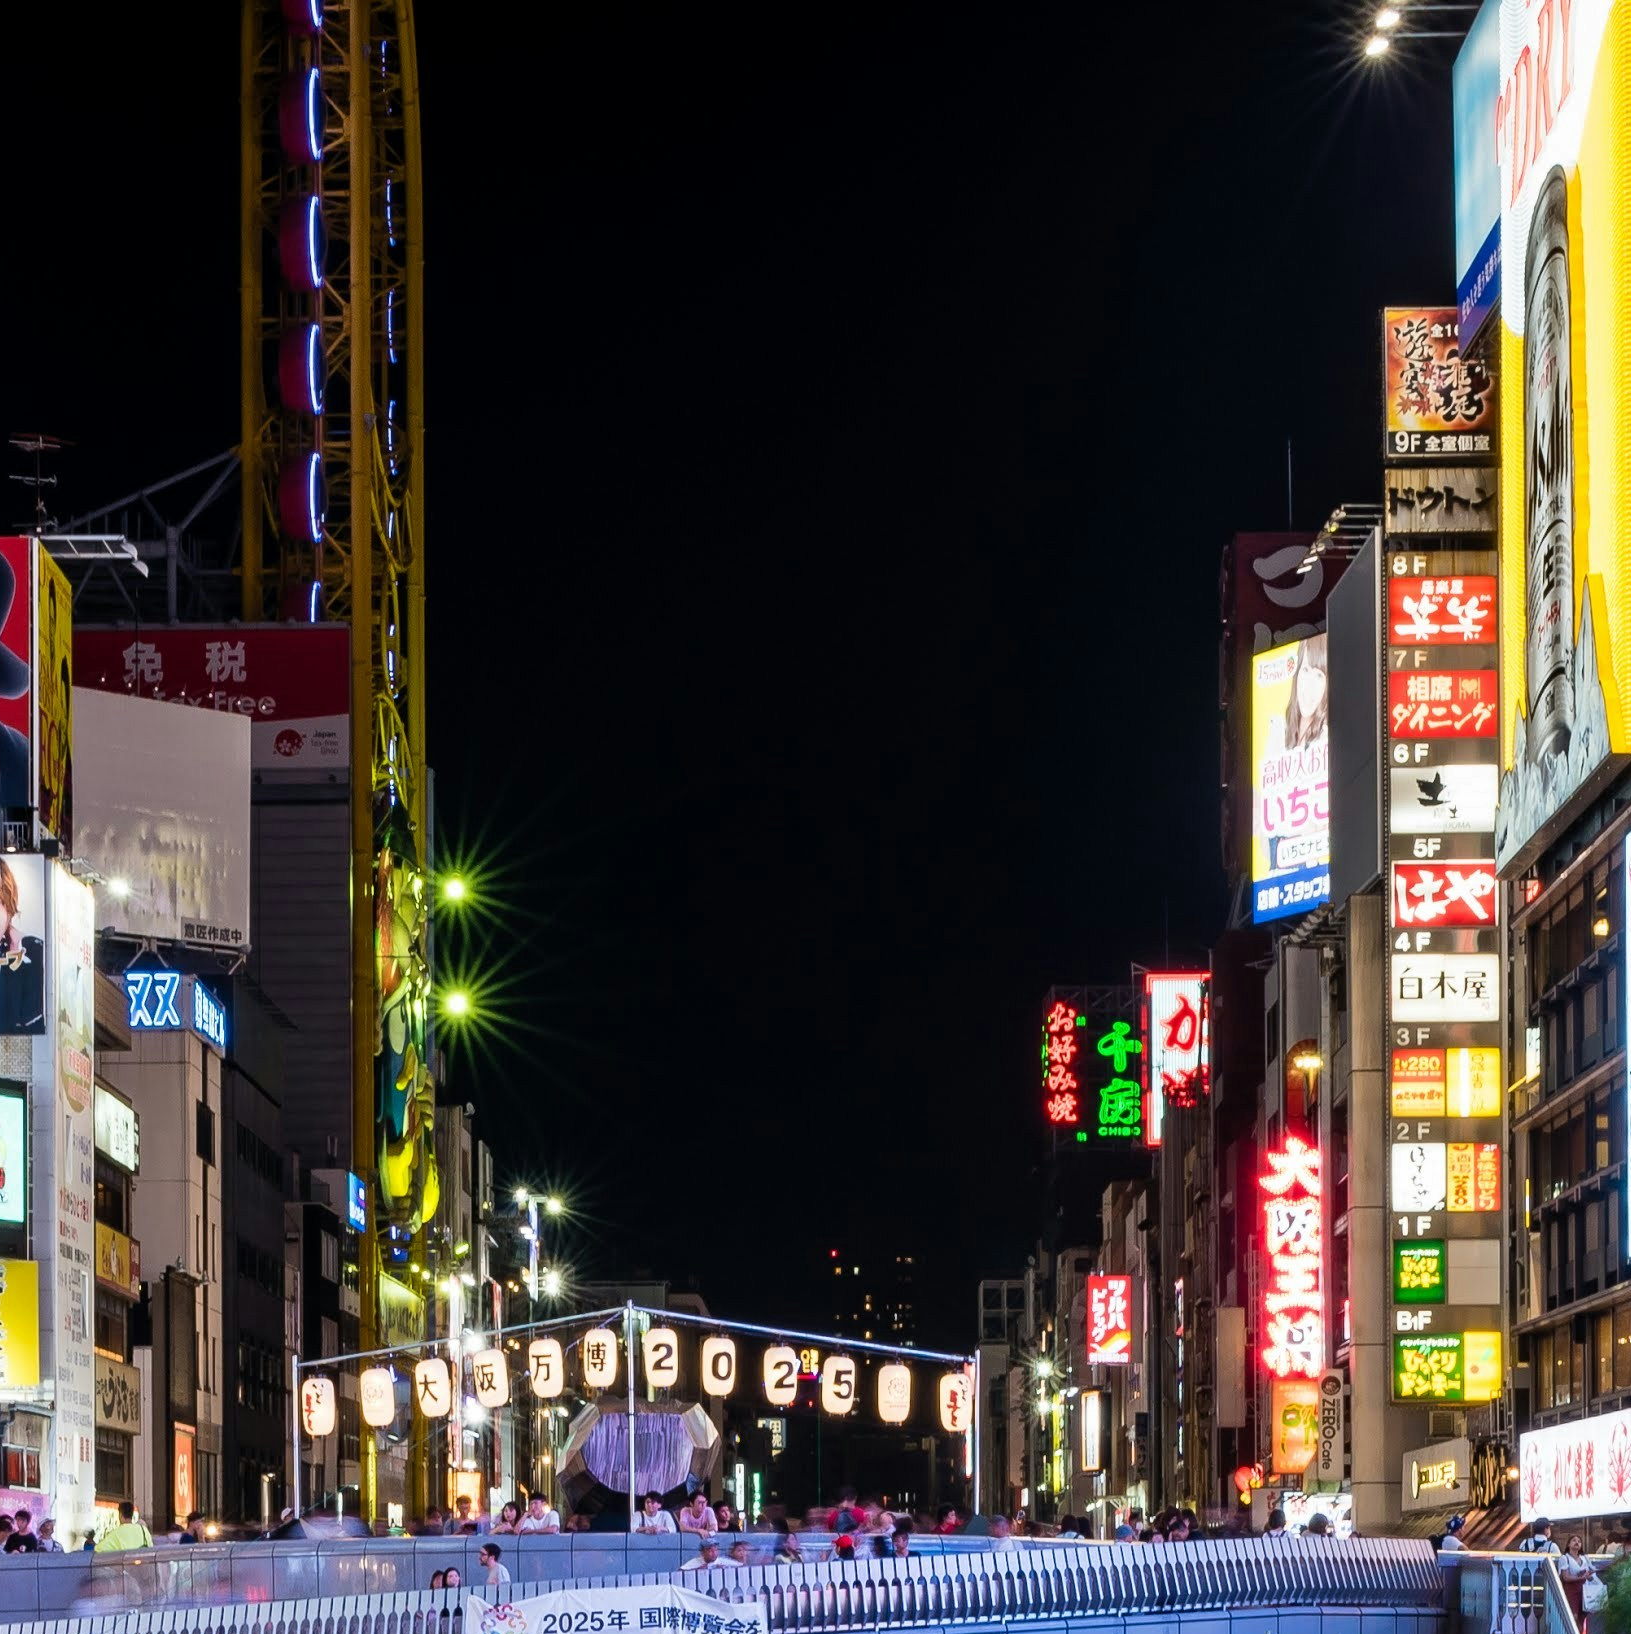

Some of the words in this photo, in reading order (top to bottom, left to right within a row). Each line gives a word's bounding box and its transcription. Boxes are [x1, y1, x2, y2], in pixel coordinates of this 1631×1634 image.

[1395, 431, 1421, 453] 9F
[1425, 435, 1490, 452] 全室個室
[1392, 555, 1428, 575] 8F
[123, 641, 247, 683] 免税
[1394, 650, 1428, 668] 7F
[1407, 676, 1453, 701] 相席
[1392, 702, 1496, 732] ダイニング
[1393, 743, 1430, 764] 6F
[1413, 838, 1442, 858] 5F
[1396, 869, 1495, 922] はや
[184, 922, 243, 944] 意匠作成中
[1394, 931, 1432, 952] 4F
[1399, 967, 1490, 1000] 白木屋
[1396, 1028, 1430, 1046] 3F
[1047, 1002, 1078, 1123] お好み焼
[1098, 1126, 1142, 1137] CHIBO
[1396, 1122, 1431, 1140] 2F
[1398, 1216, 1432, 1236] 1F
[1259, 1136, 1323, 1378] 大阪王将
[1091, 1288, 1108, 1343] ドラッグ
[1107, 1279, 1127, 1330] ツルハ
[1396, 1310, 1433, 1331] B1F
[651, 1341, 854, 1399] 2025
[1402, 1349, 1458, 1375] びっくり
[1399, 1372, 1461, 1397] ドンキー
[1322, 1399, 1336, 1439] ZERO
[1322, 1440, 1333, 1471] cafe
[542, 1609, 629, 1634] 2025年
